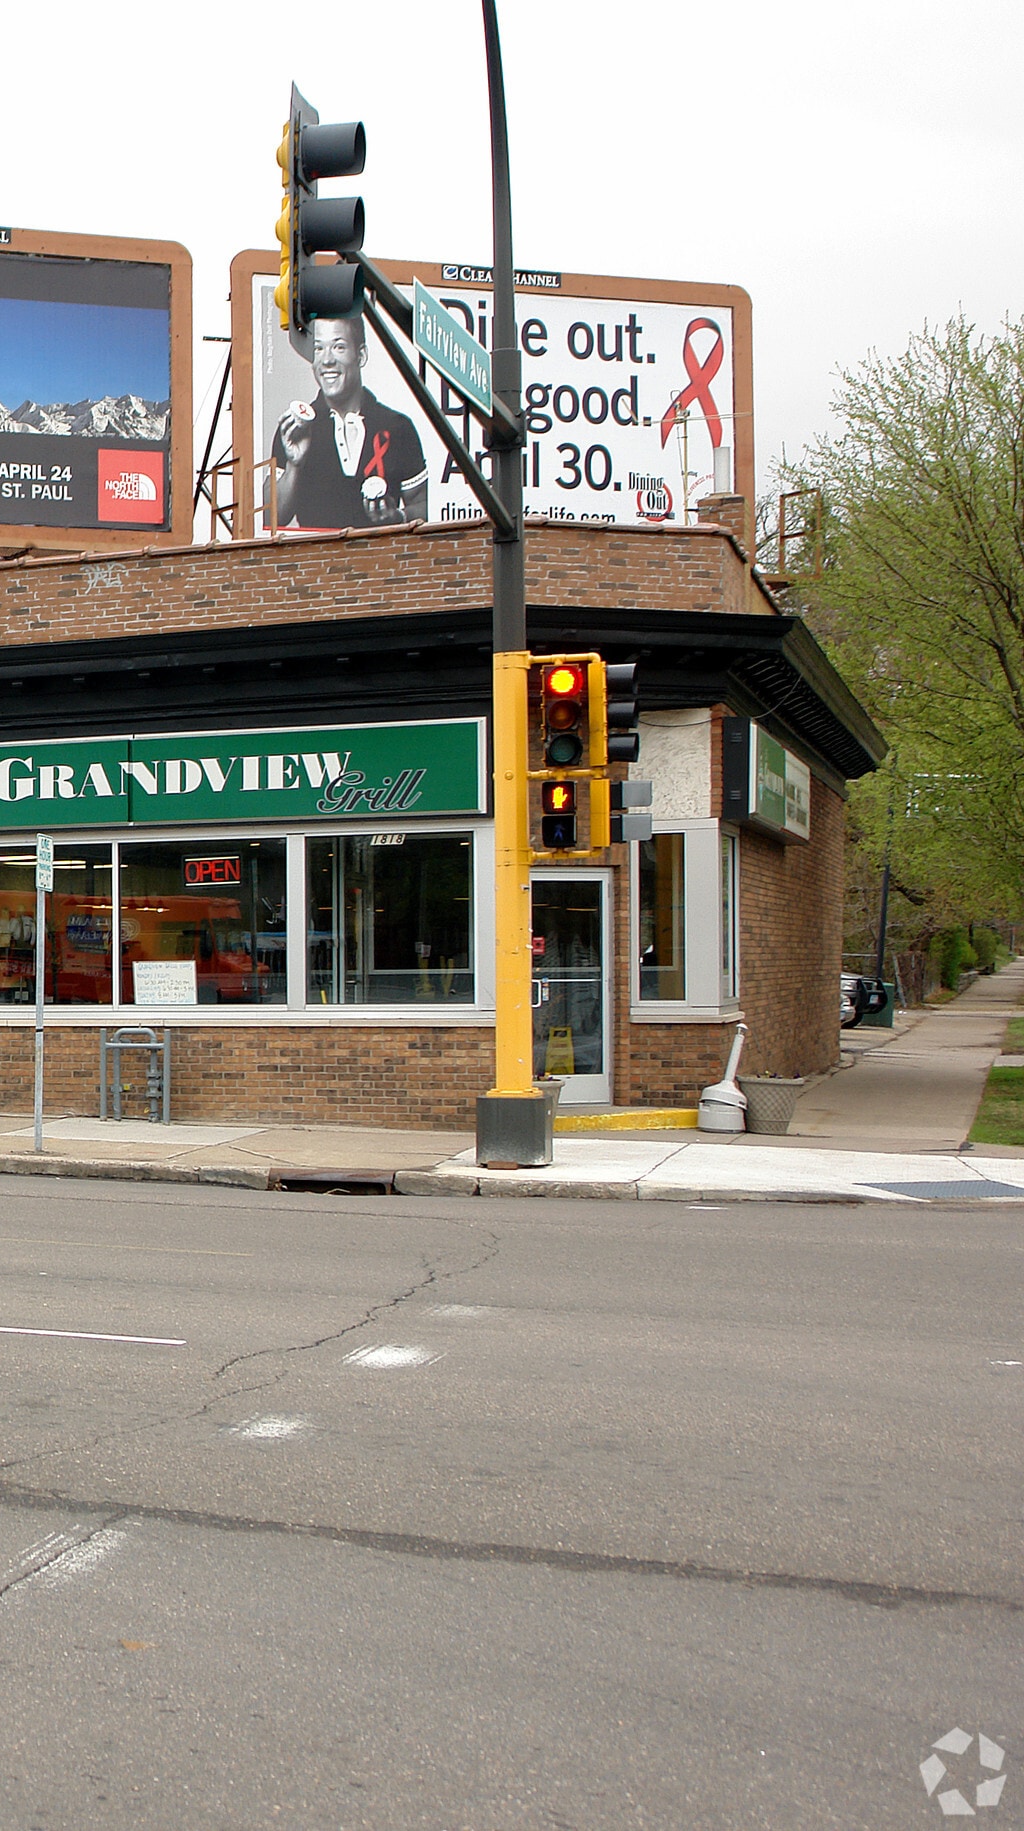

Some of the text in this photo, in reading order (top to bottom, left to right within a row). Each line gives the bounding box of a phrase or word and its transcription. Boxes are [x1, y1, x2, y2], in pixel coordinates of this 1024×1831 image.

[460, 266, 560, 287] CLEAHANNEL
[420, 301, 467, 375] Fairview
[567, 313, 656, 364] out.
[526, 375, 652, 434] good.
[50, 465, 74, 483] 24
[119, 472, 140, 482] THE
[555, 442, 622, 492] 30.
[1, 481, 27, 501] ST.
[32, 483, 74, 502] PAUL
[104, 480, 140, 491] NORTH
[115, 490, 140, 500] FACE
[629, 471, 664, 496] Dining
[647, 490, 667, 510] Out
[316, 768, 427, 813] Grill
[184, 858, 241, 883] OPEN
